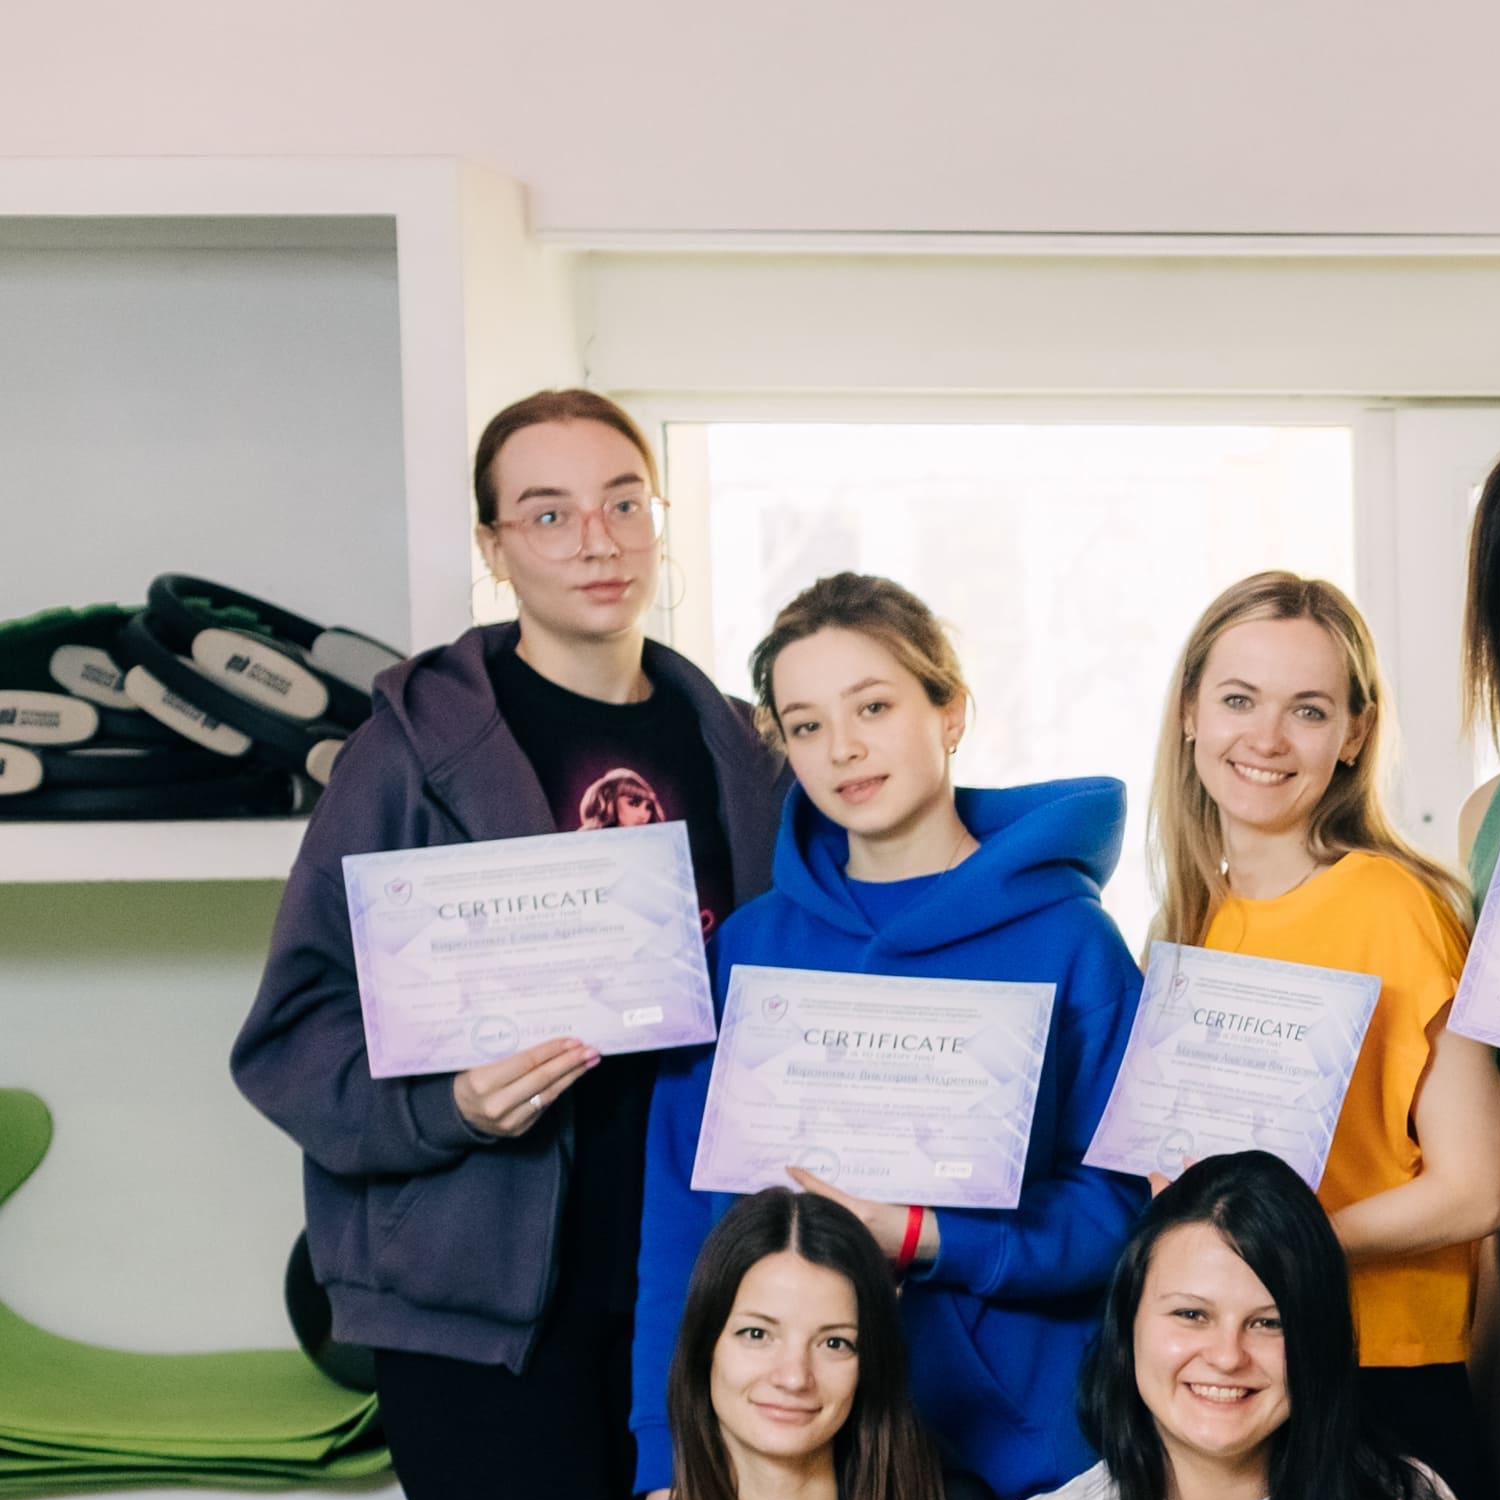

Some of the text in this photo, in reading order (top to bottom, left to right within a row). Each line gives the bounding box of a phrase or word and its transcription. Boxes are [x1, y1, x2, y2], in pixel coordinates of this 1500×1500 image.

[436, 886, 611, 921] CERTIFICATE
[801, 1027, 966, 1054] CERTIFICATE
[1190, 1006, 1307, 1043] CERTIFICATE
